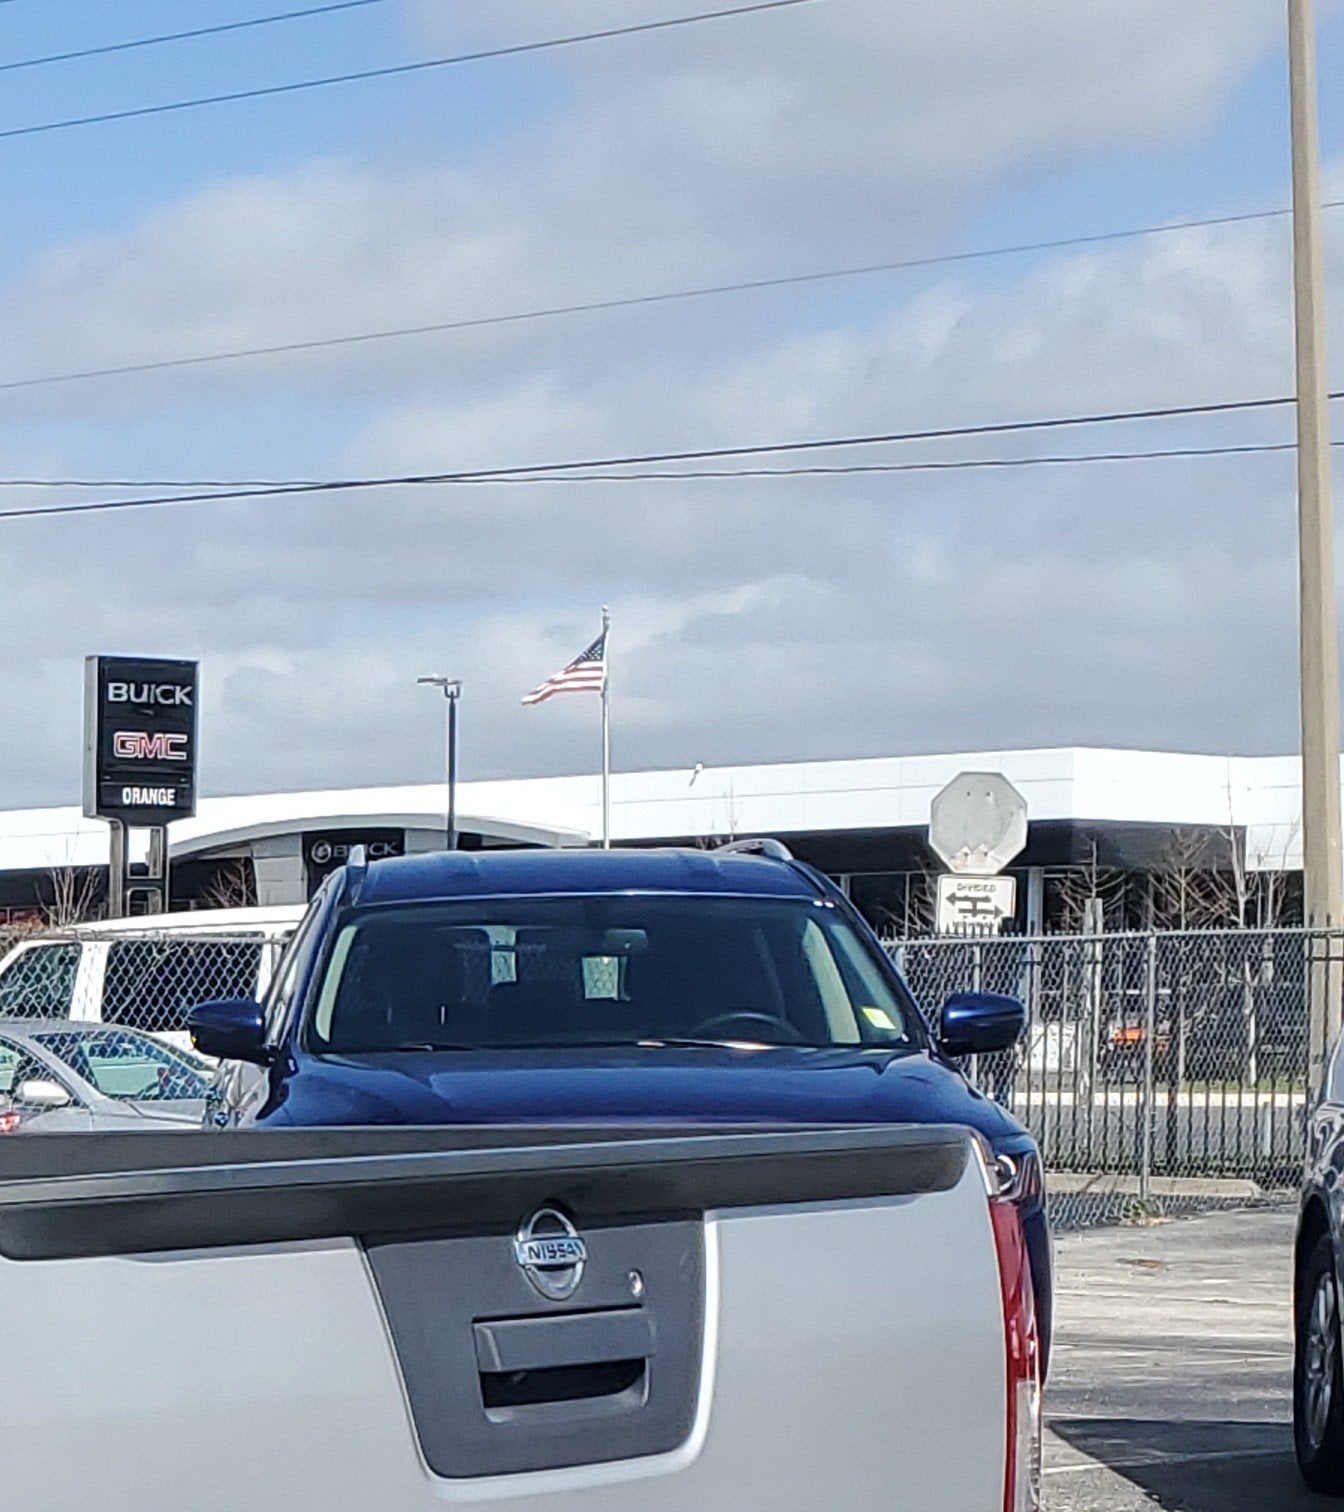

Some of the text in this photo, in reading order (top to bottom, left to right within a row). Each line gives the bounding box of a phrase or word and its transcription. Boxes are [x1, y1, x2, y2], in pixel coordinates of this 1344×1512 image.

[107, 682, 194, 706] BUICK
[113, 730, 189, 761] GMC
[122, 786, 177, 806] ORANGE
[332, 842, 401, 858] BICK
